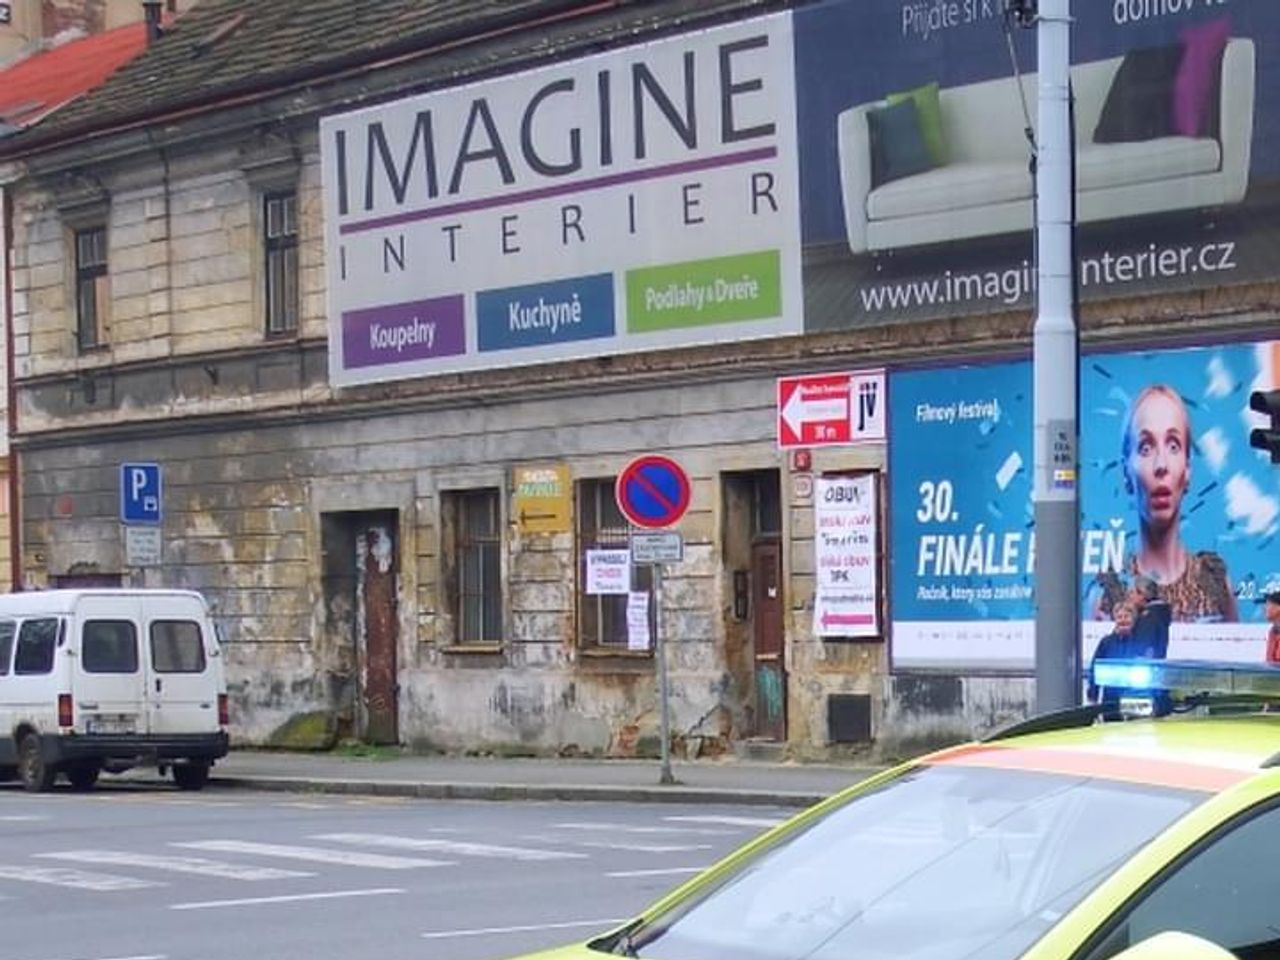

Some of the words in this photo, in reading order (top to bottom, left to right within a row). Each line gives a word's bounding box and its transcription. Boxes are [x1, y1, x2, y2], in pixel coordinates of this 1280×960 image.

[335, 34, 777, 216] IMAGINE
[340, 171, 779, 281] INTERIER
[369, 317, 437, 353] Koupelny
[508, 292, 582, 335] Kuchyně
[132, 469, 147, 500] P
[917, 480, 959, 522] 30.
[917, 524, 1021, 577] FINÁLE
